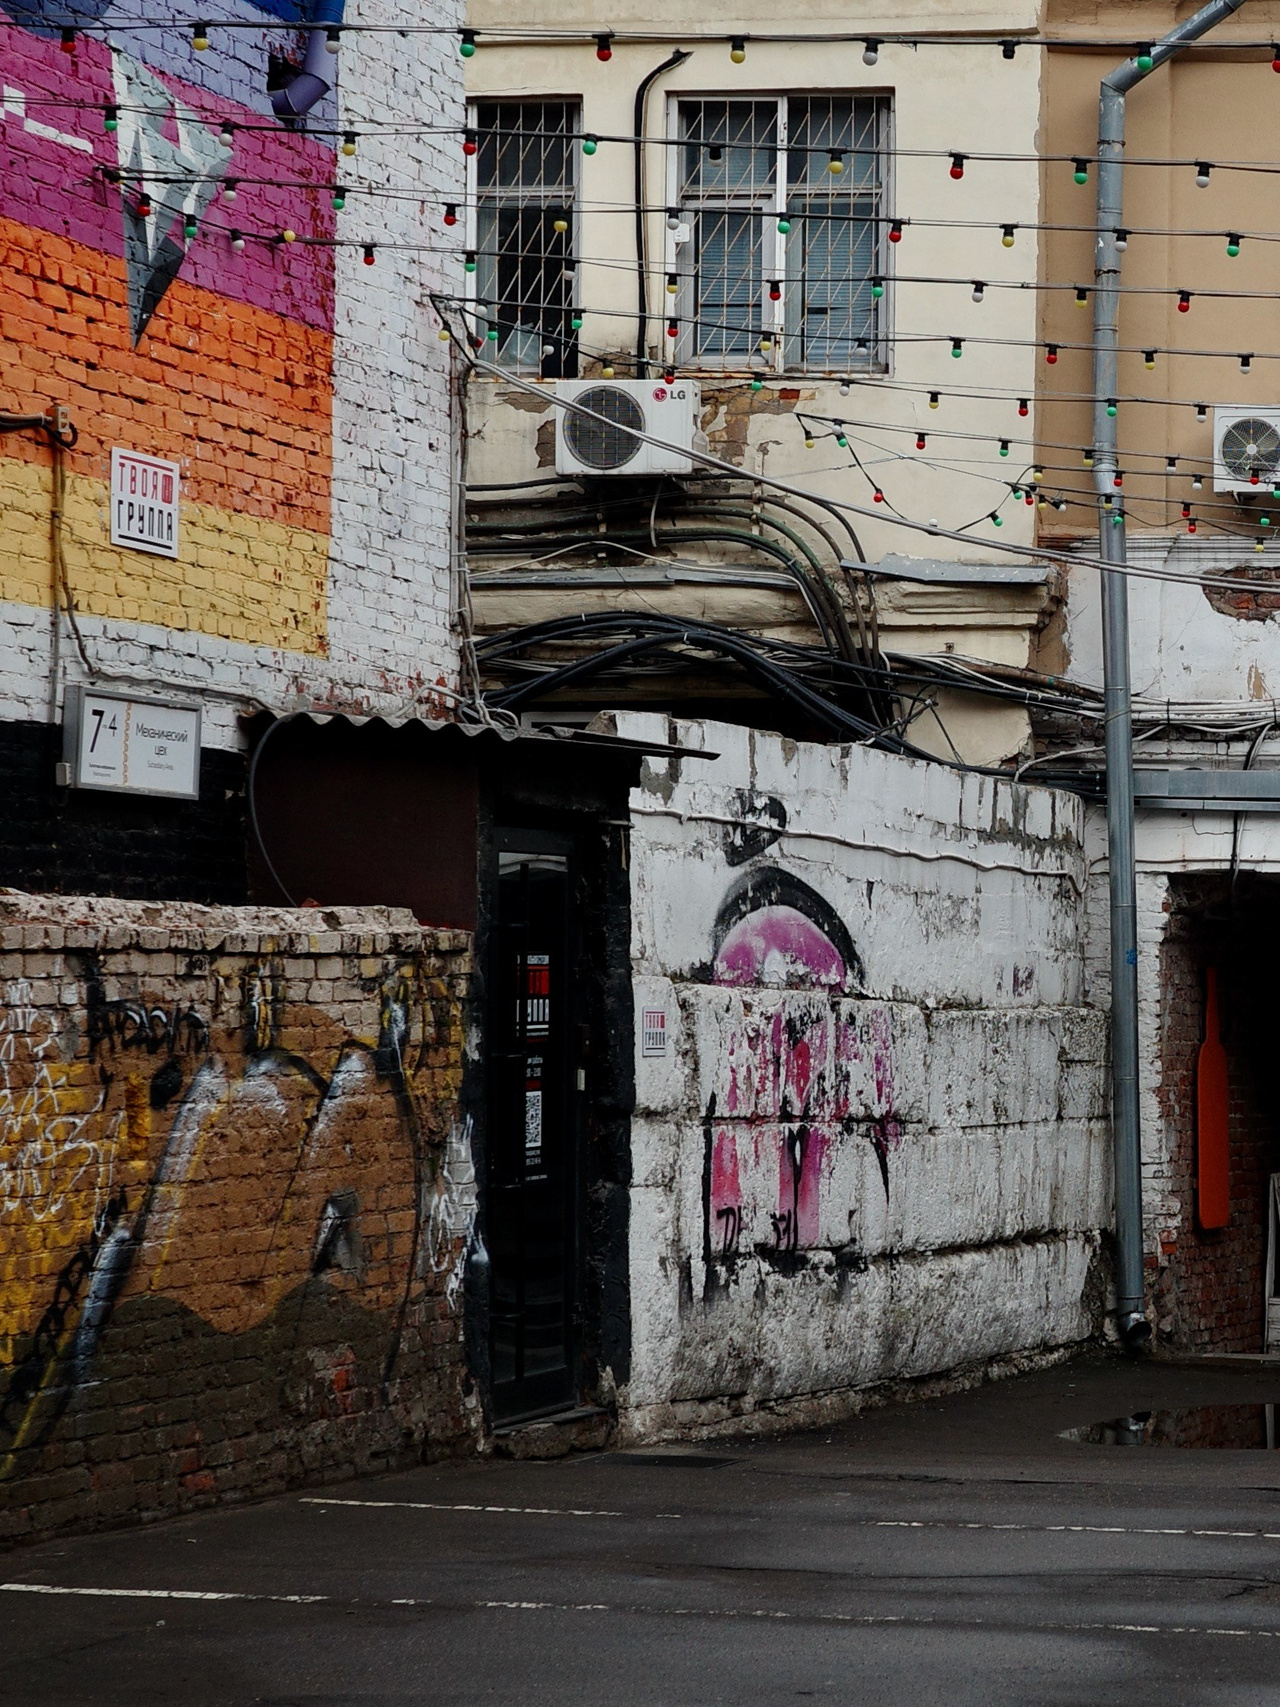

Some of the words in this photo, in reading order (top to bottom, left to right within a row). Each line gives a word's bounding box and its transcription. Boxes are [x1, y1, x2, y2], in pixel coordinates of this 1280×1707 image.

[670, 390, 686, 400] LG
[119, 462, 158, 500] ТВОЯ
[118, 499, 173, 541] ГРУППА
[90, 708, 105, 753] 7
[108, 713, 118, 737] 4
[645, 1031, 665, 1046] ГРУППА
